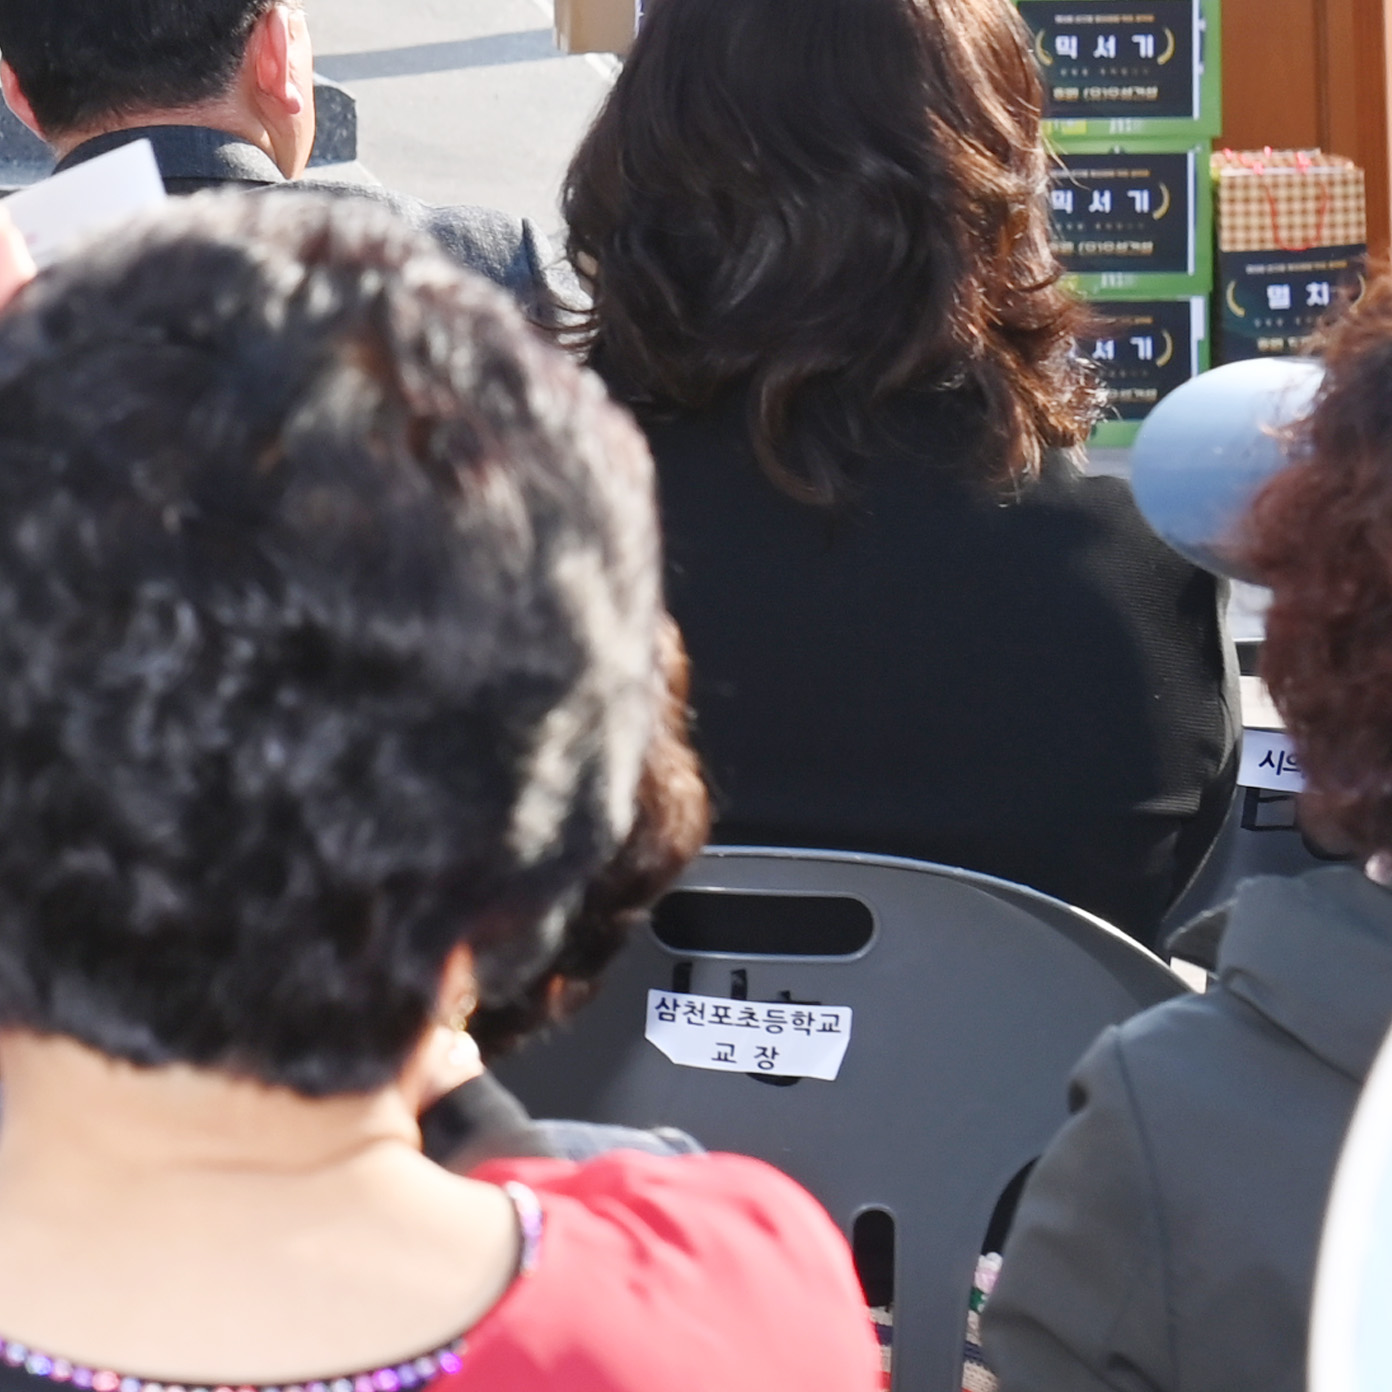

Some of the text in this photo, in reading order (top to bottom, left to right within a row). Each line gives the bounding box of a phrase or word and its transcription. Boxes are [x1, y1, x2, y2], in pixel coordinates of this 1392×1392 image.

[1055, 34, 1155, 60] 믹서기
[654, 996, 842, 1036] 삼천포초등학교
[711, 1041, 780, 1071] 교장
